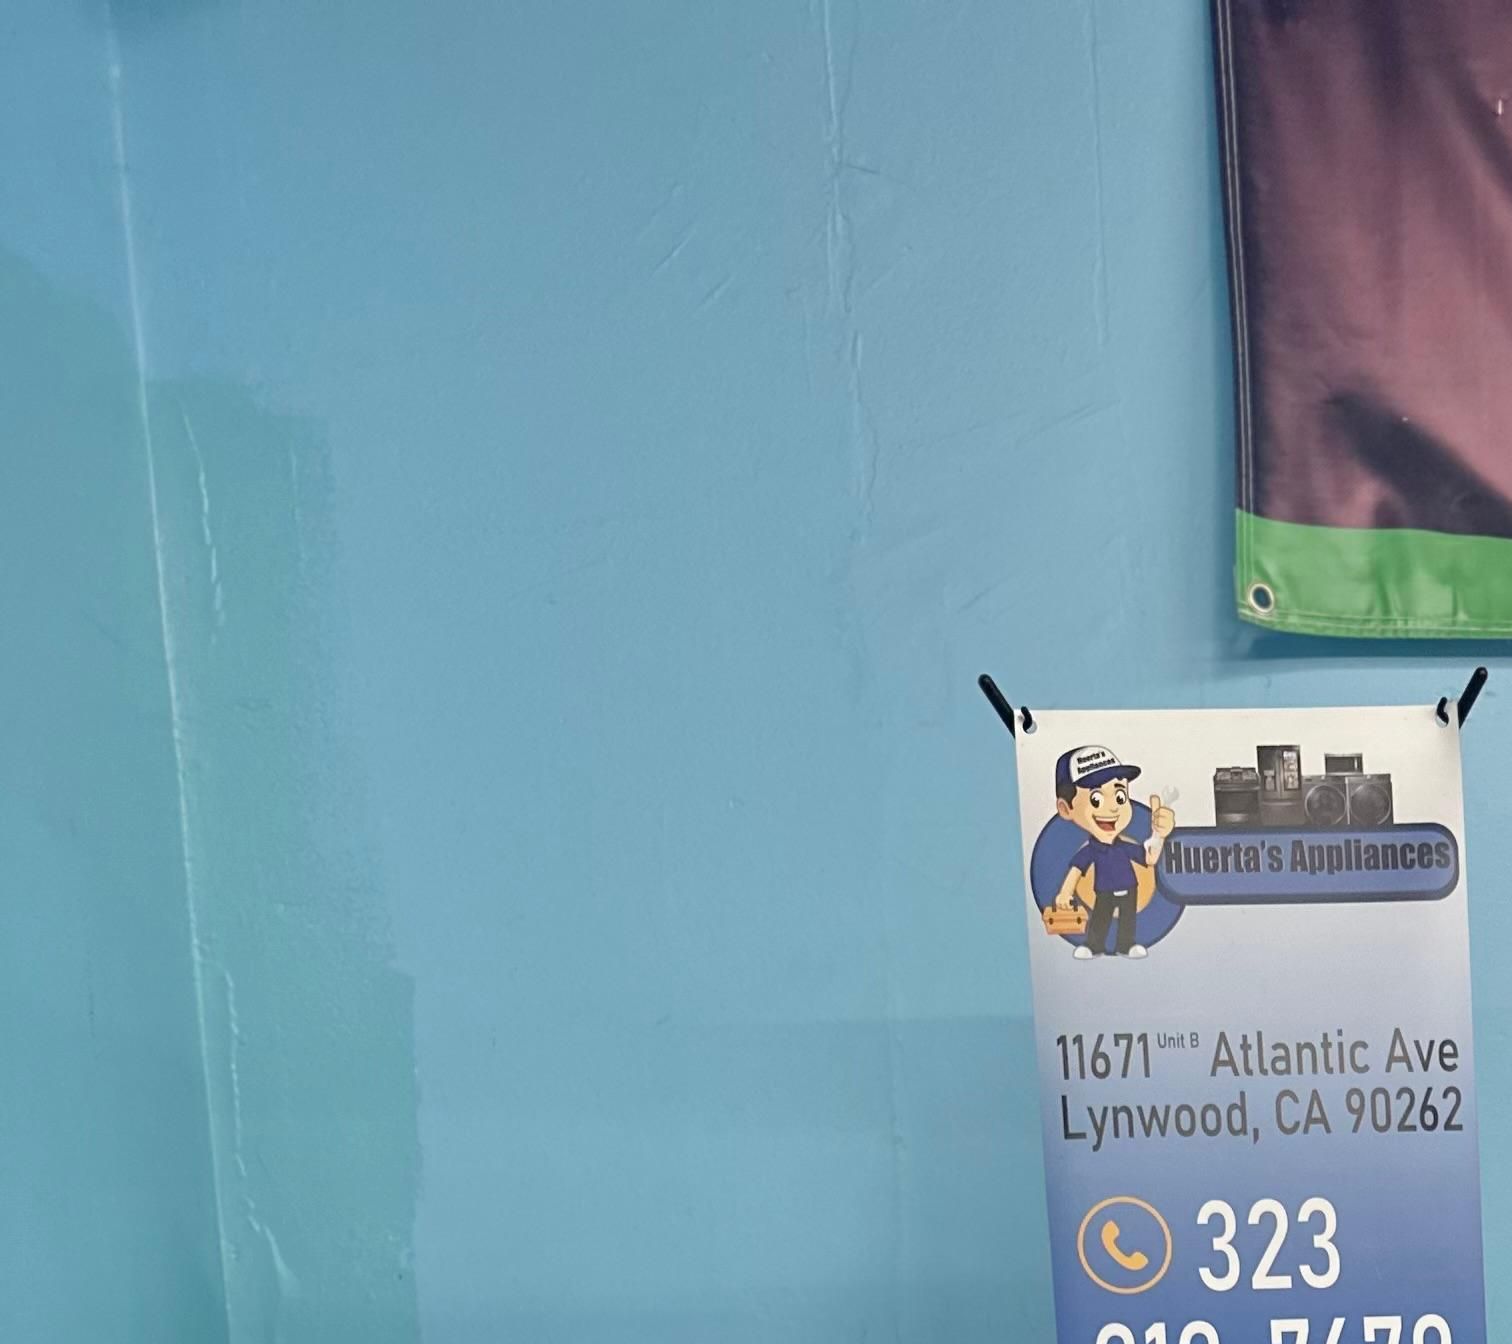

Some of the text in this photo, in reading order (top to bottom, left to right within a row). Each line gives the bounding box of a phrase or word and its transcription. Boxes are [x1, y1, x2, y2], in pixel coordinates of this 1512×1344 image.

[1165, 838, 1451, 875] Huerta's Appliances
[1056, 1027, 1459, 1080] 11671 Unit B Atlantic Ave
[1061, 1085, 1464, 1152] Lynwood, CA 90262
[1196, 1196, 1341, 1292] 323
